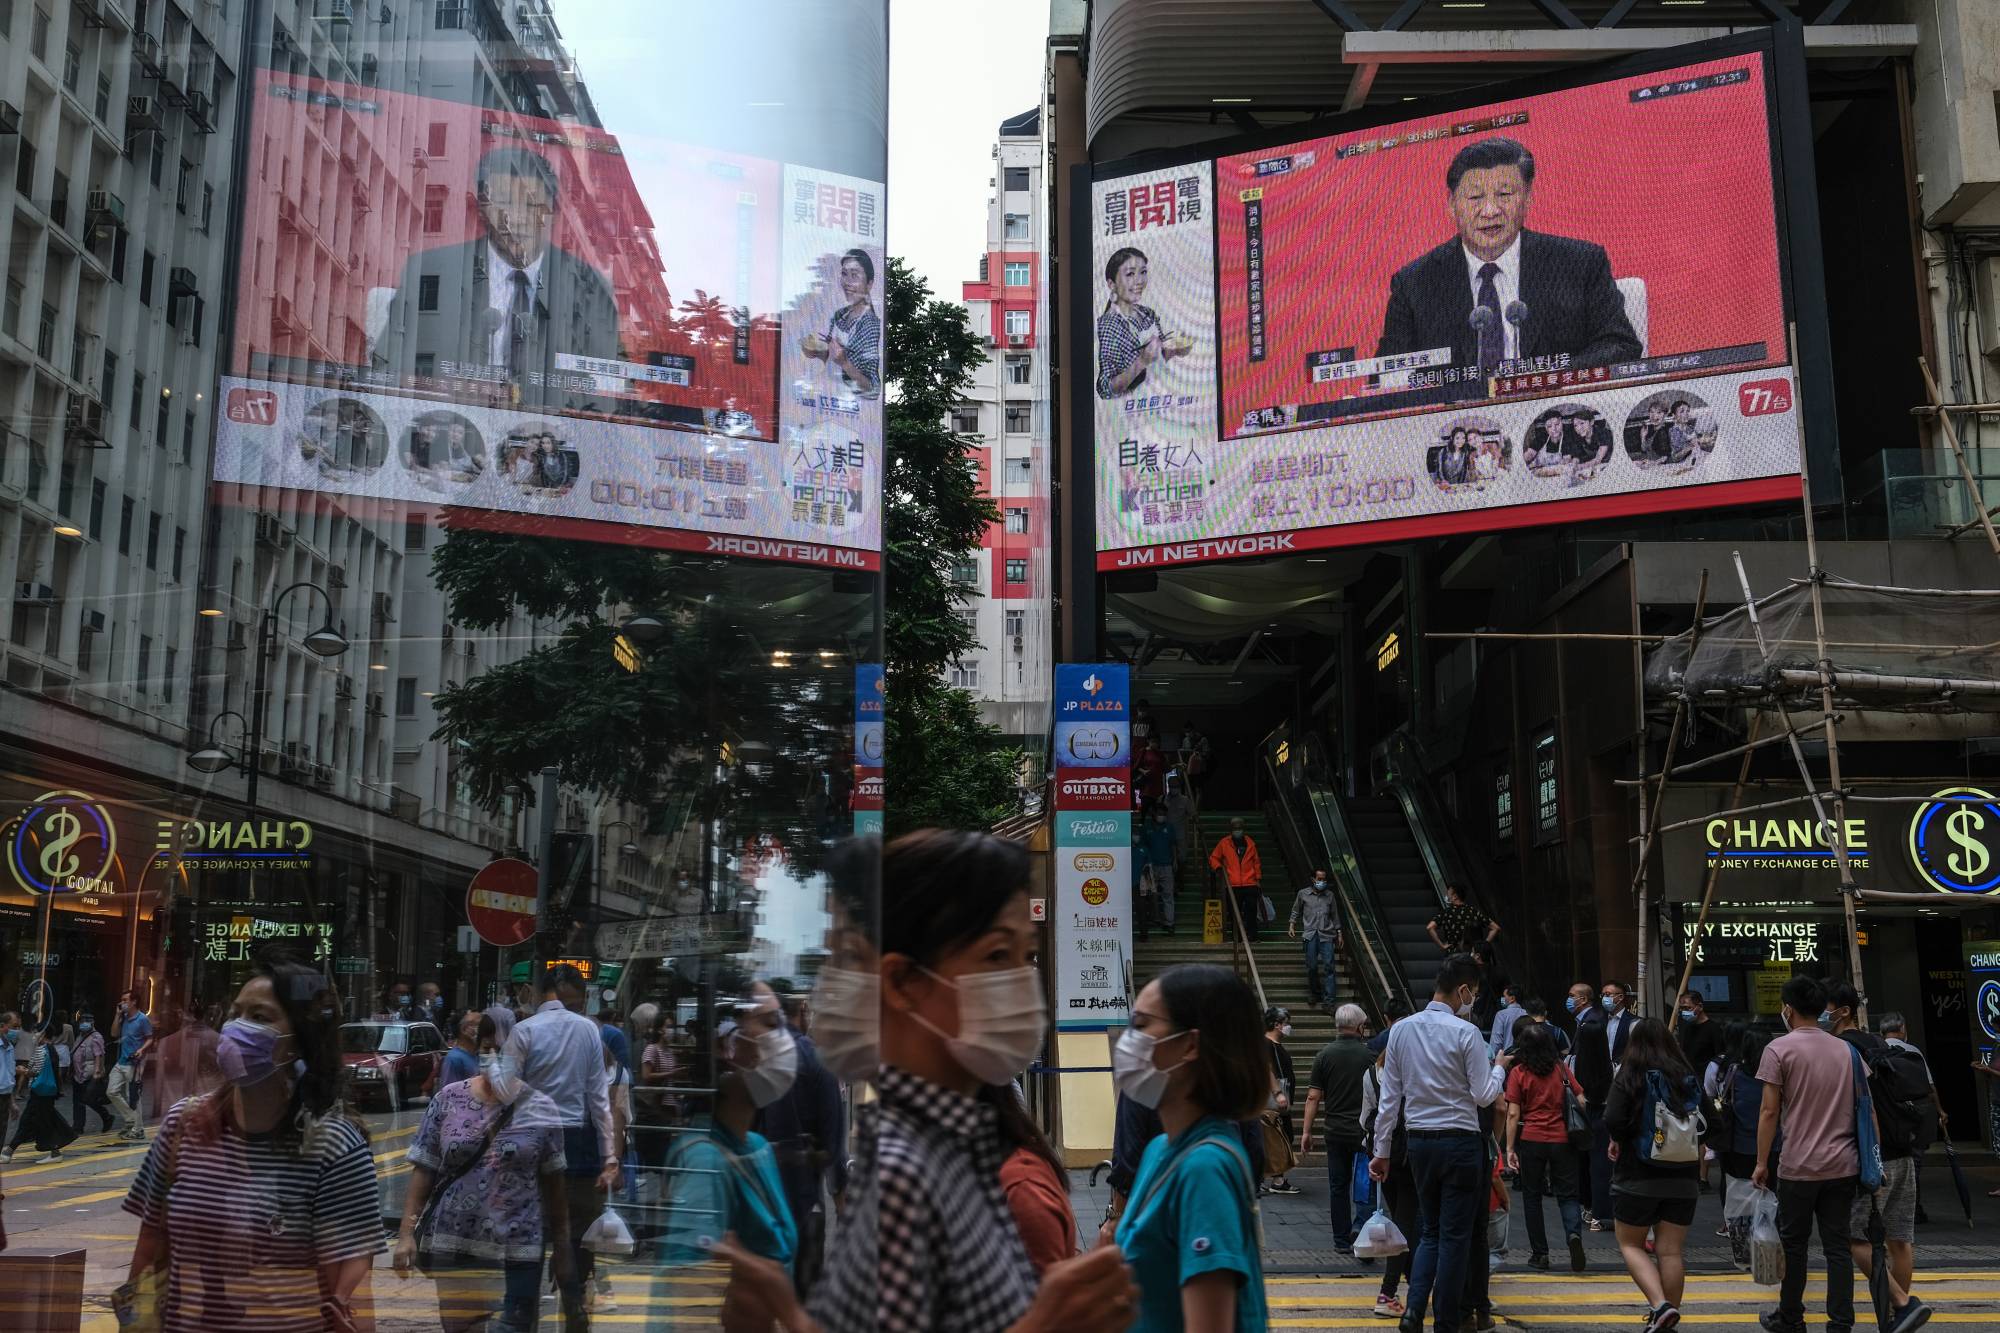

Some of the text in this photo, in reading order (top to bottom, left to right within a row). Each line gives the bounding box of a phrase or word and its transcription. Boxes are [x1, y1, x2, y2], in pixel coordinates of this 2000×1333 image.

[1119, 438, 1203, 474] 自煮女人
[1118, 534, 1296, 567] JM NETWORK
[1063, 701, 1124, 711] JP PLAZA
[1062, 784, 1126, 795] OUTBACK
[1070, 819, 1119, 838] Festiva
[1706, 818, 1868, 849] CHANGE
[1753, 859, 1819, 869] EXCHANGE
[1822, 859, 1869, 869] CETRE
[66, 875, 116, 895] GOUTAL
[1721, 923, 1818, 937] EXCHANGE
[1769, 938, 1819, 963] 汇款
[1080, 970, 1109, 981] SUPER
